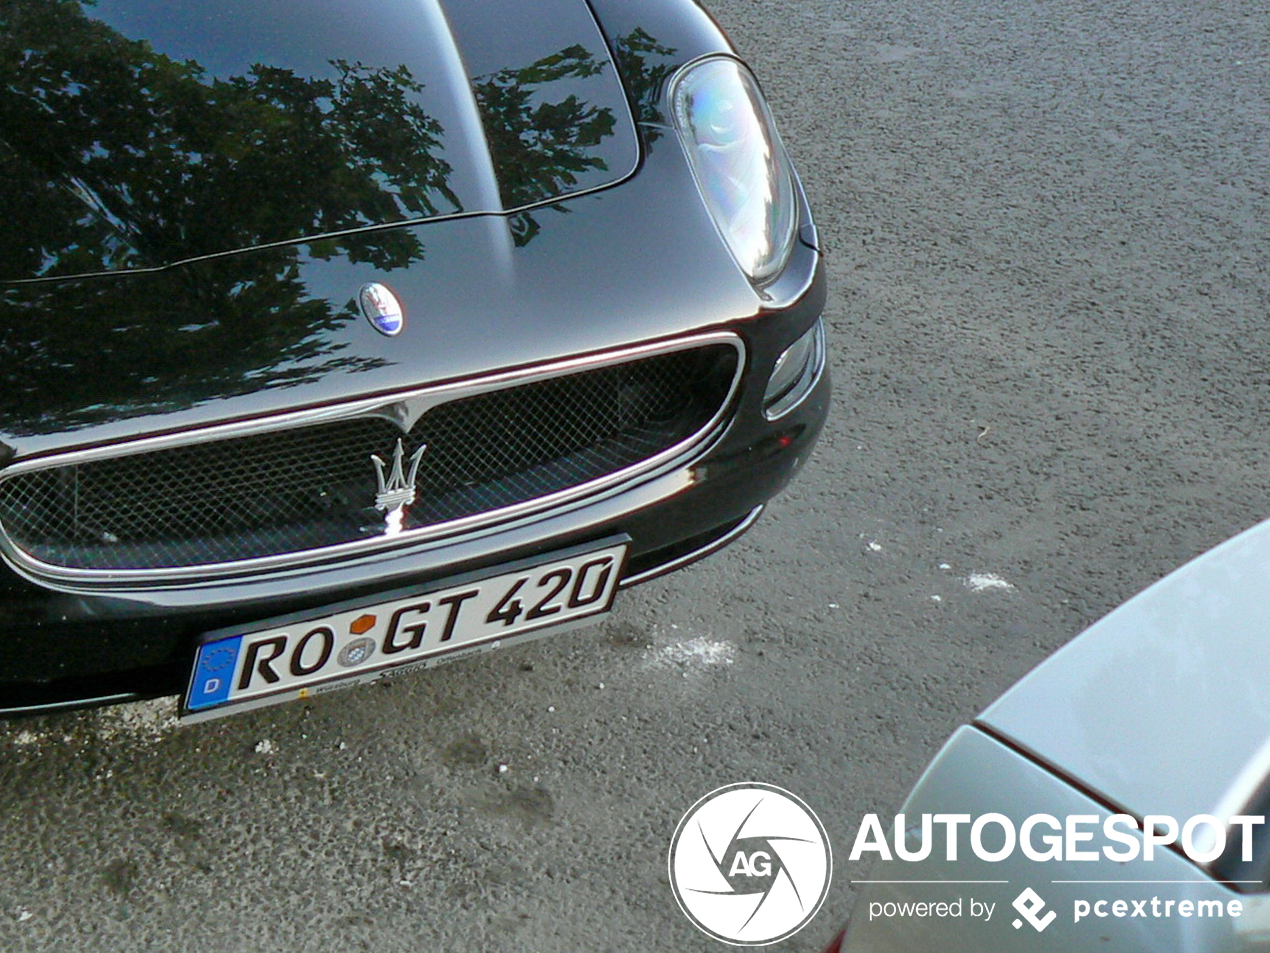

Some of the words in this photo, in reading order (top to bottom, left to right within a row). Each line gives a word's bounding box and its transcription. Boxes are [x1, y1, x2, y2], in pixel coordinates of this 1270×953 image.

[238, 627, 335, 690] RO
[381, 589, 480, 654] GT
[485, 555, 615, 626] 420
[203, 677, 220, 694] D
